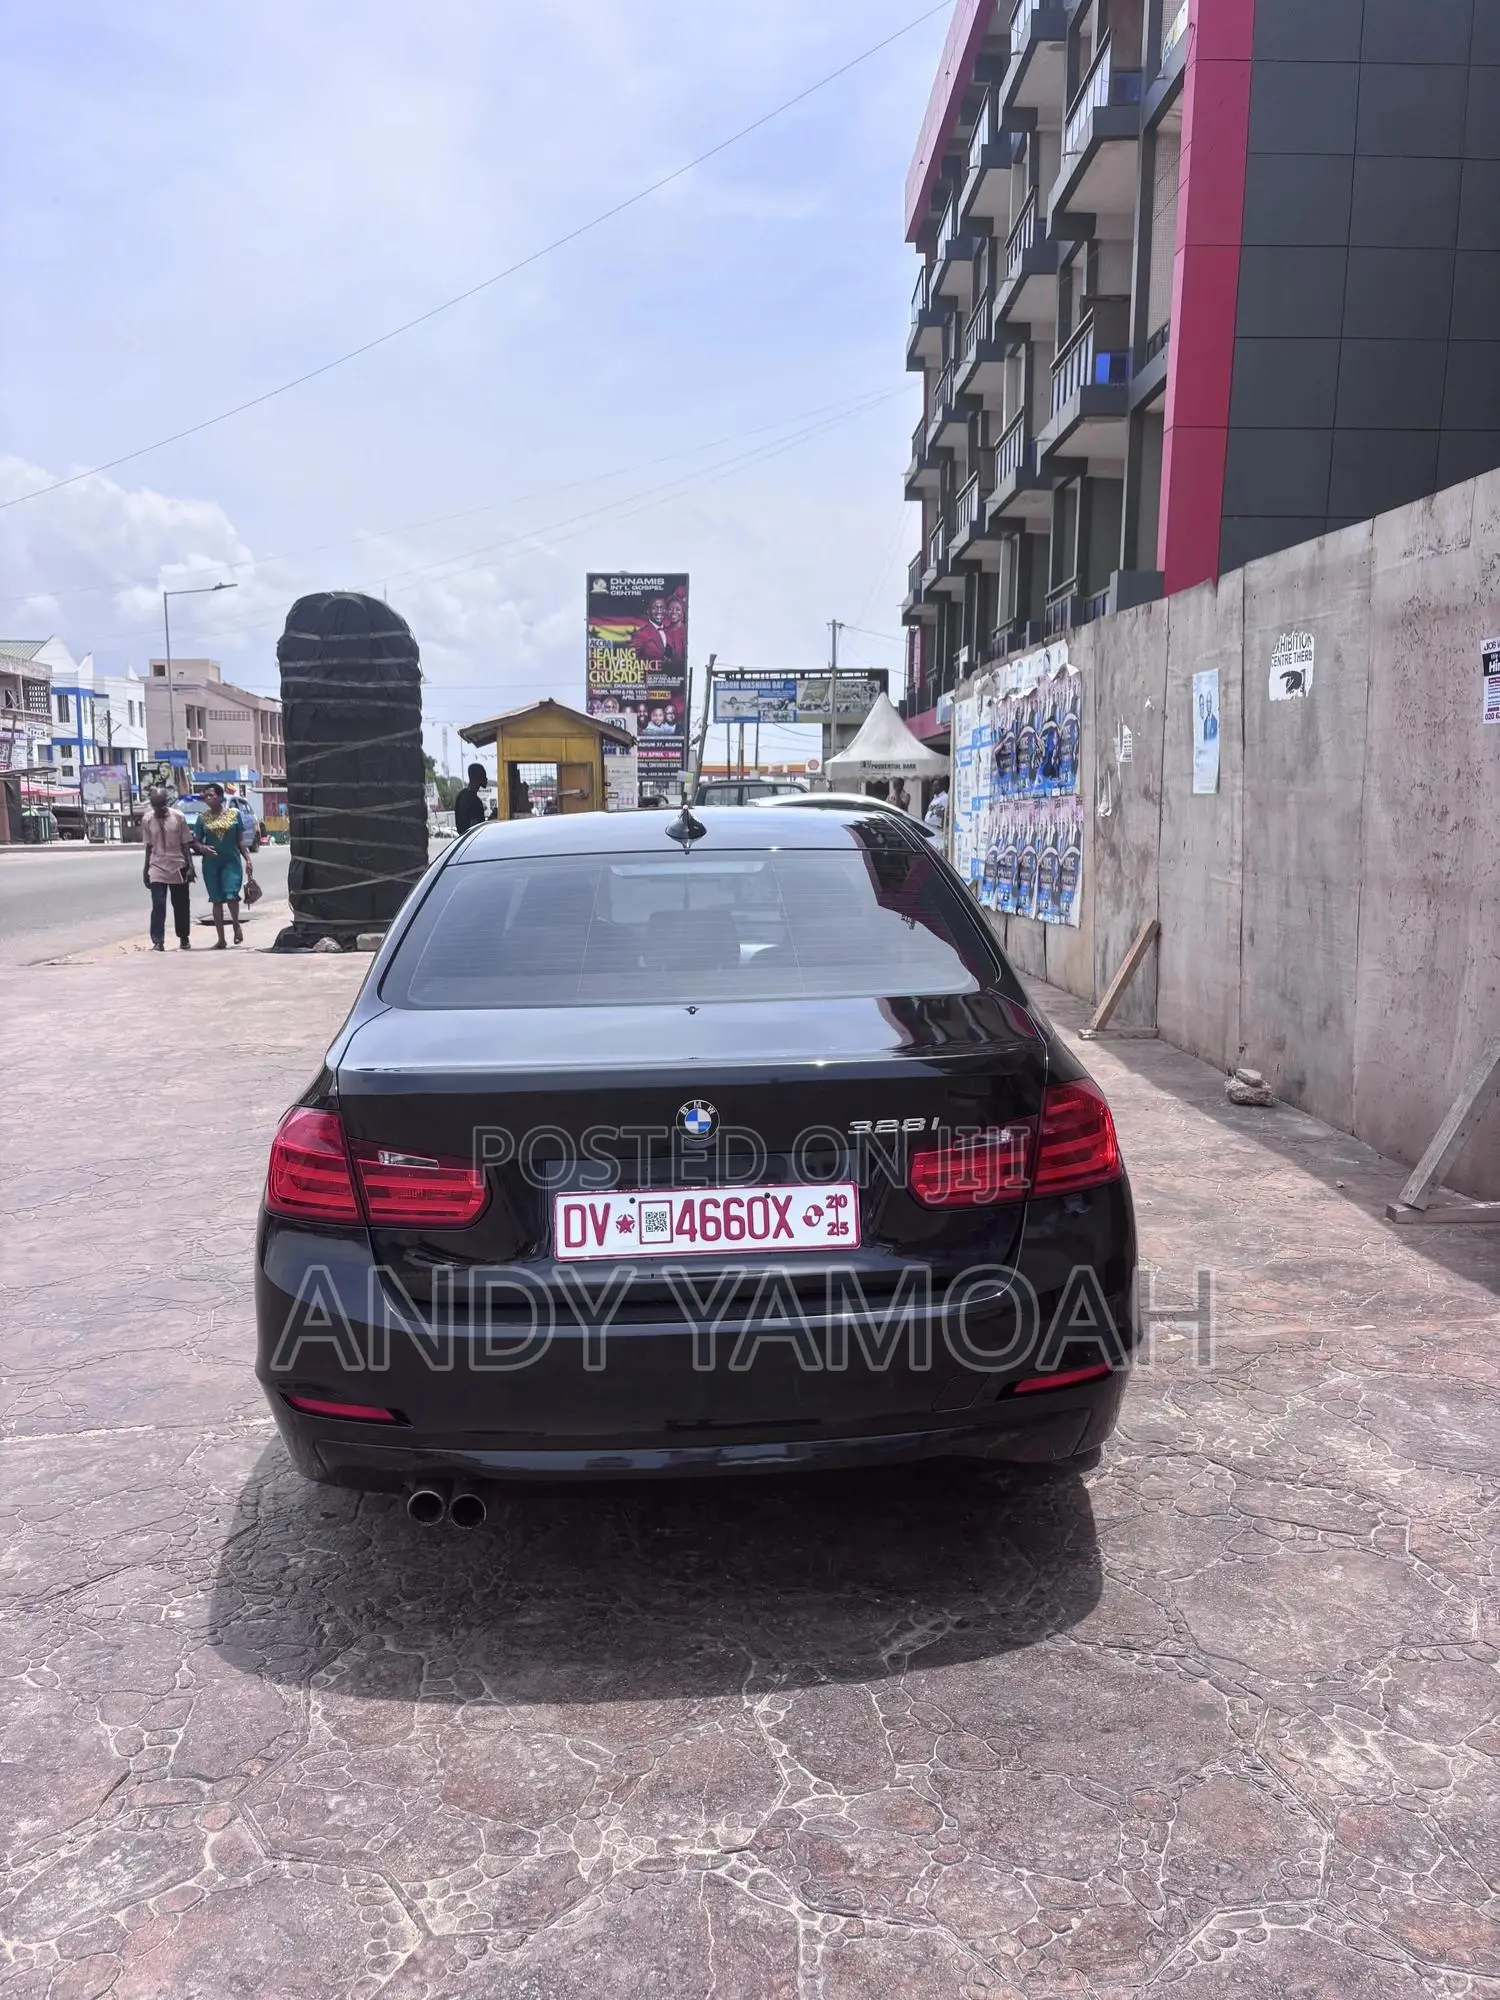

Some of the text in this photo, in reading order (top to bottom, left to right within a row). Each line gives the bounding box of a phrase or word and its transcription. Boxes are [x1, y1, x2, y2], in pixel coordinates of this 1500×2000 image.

[589, 640, 612, 648] ACCRA
[589, 648, 636, 659] HEALING
[589, 659, 662, 671] DELIVERANCE
[589, 671, 645, 683] CRUSADE
[740, 681, 771, 689] WASHING
[771, 681, 785, 689] BAY
[826, 1193, 848, 1209] 20
[563, 1202, 611, 1248] DV
[826, 1221, 849, 1236] 25
